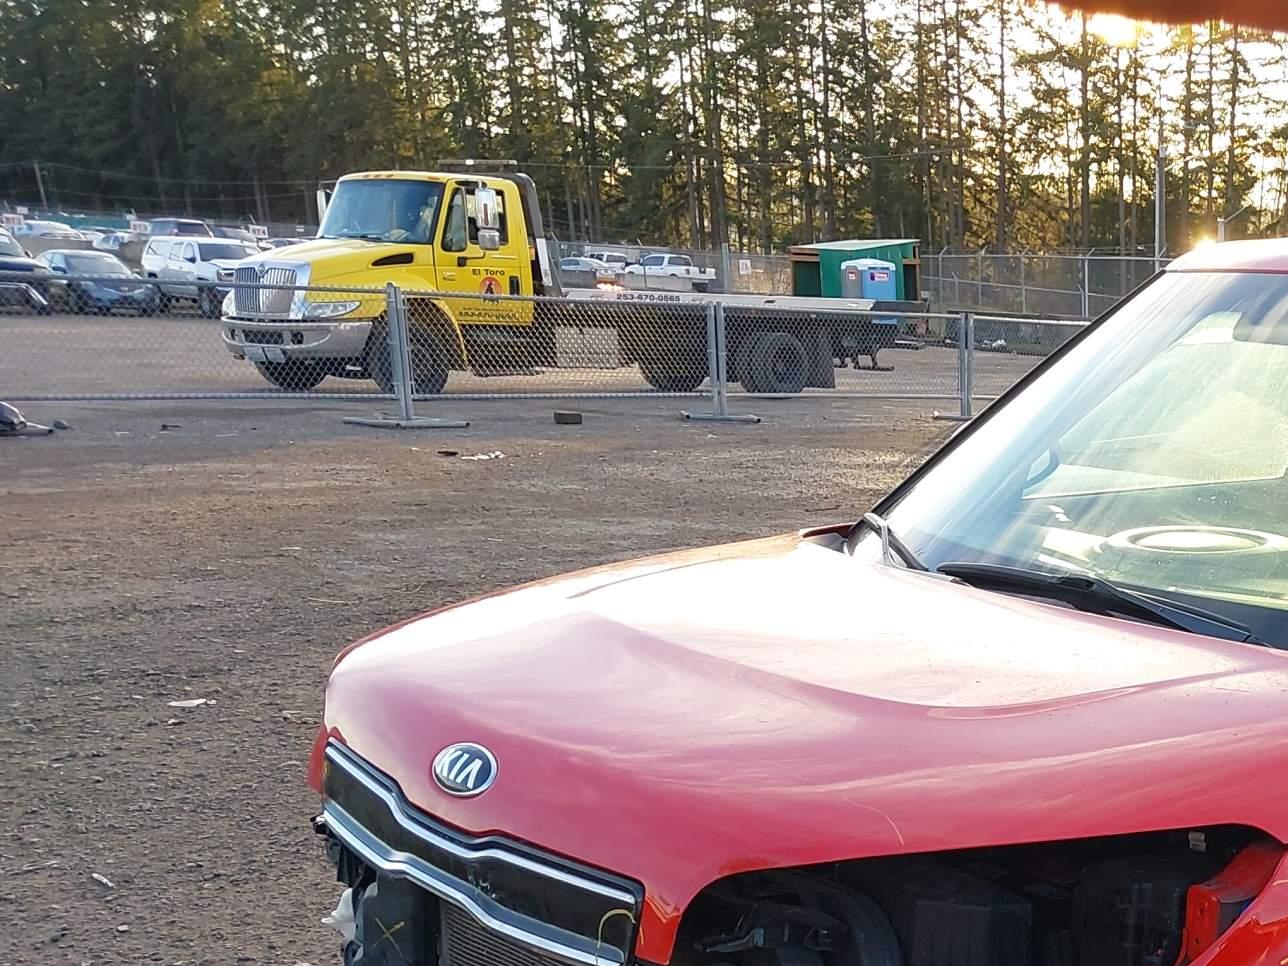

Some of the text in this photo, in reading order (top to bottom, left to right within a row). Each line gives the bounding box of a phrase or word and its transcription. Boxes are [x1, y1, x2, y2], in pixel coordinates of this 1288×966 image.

[484, 268, 505, 276] Toro
[616, 293, 681, 302] 253-670-0565
[434, 748, 483, 789] KIA
